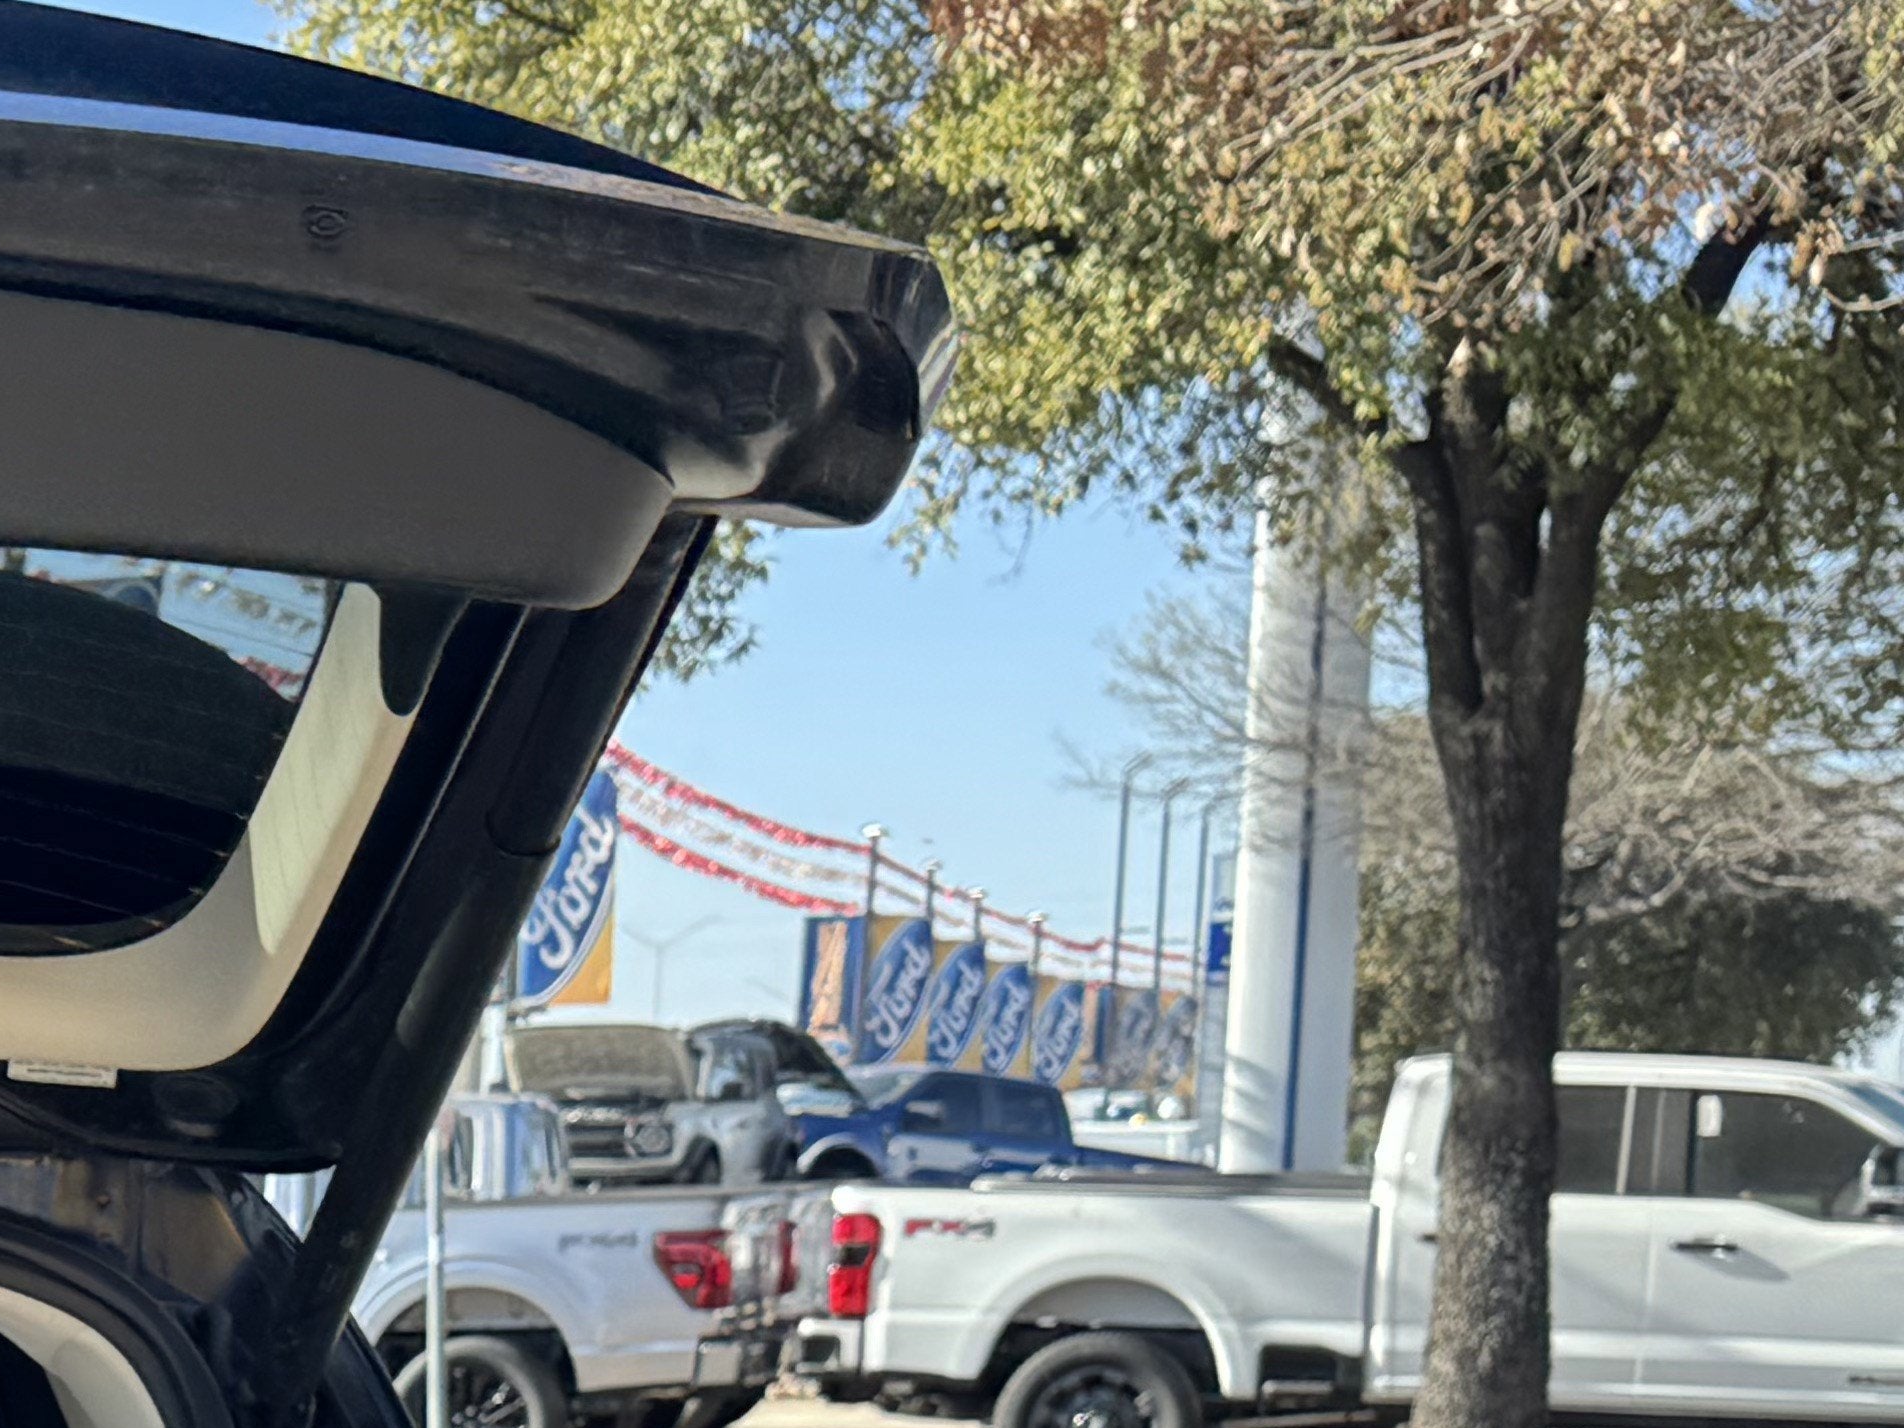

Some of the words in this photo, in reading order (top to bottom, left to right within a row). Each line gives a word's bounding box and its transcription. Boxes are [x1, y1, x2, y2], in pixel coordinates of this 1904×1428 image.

[520, 804, 615, 970] Ford
[864, 938, 931, 1048] Ford
[929, 958, 984, 1059] Ford
